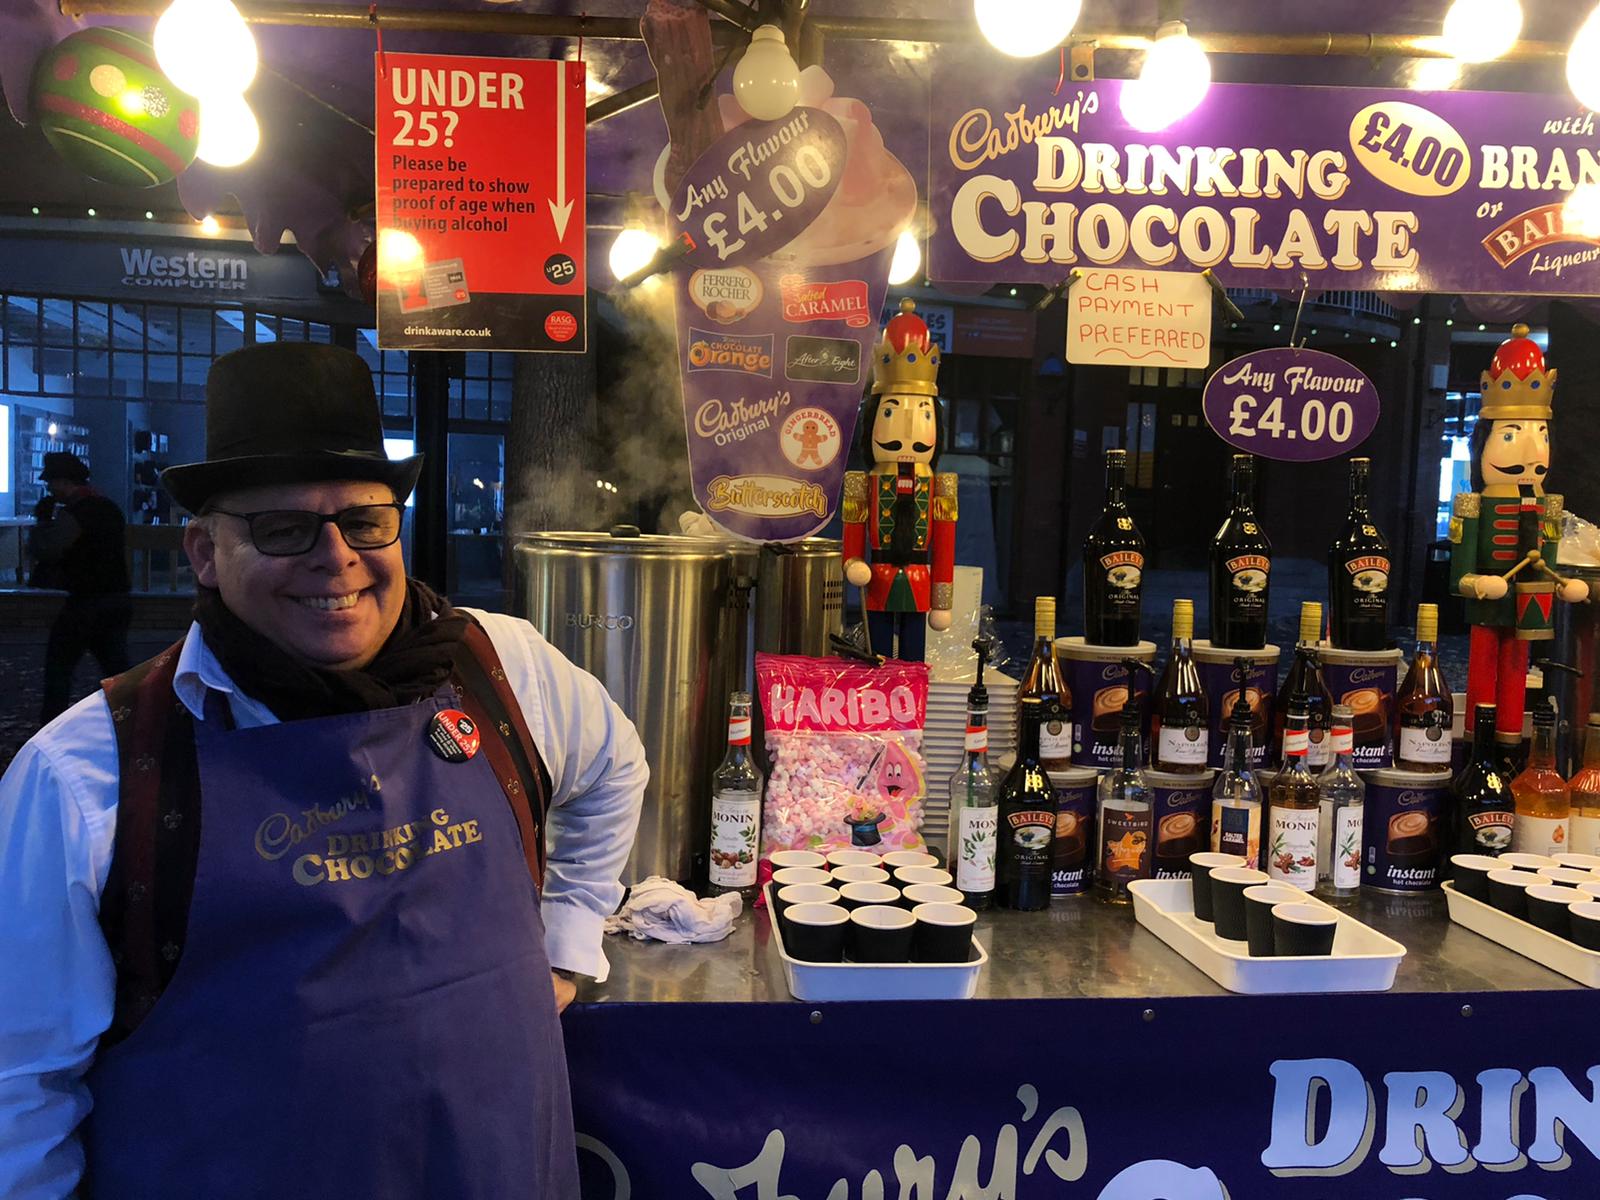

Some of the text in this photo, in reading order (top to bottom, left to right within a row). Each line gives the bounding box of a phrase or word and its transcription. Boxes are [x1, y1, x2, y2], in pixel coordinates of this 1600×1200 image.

[392, 67, 525, 110] UNDER
[392, 110, 459, 148] 25?
[949, 90, 1099, 171] Cadbury's
[1543, 112, 1594, 136] with
[1358, 111, 1465, 188] £4.00
[393, 155, 467, 172] Please be
[677, 110, 810, 223] Any Flavour
[1033, 136, 1350, 200] DRINKING
[393, 176, 530, 194] prepared to show
[393, 194, 536, 214] proof of age when
[703, 145, 831, 261] £4.00
[393, 215, 508, 234] buying alcohol
[951, 174, 1420, 273] CHOCOLATE
[120, 248, 248, 279] Western
[121, 277, 247, 289] COMPUTER
[702, 274, 752, 289] FERRERO
[702, 286, 750, 300] ROCHER
[1086, 272, 1159, 292] CASH
[785, 296, 867, 318] CARAMEL
[1078, 296, 1195, 318] PAYMENT
[404, 325, 492, 338] drinkaware.co.uk
[1079, 323, 1206, 350] PREFERRED
[690, 339, 771, 372] Orange
[711, 341, 764, 353] CHOCOLATE
[1223, 362, 1365, 396] Any Flavour
[694, 390, 791, 438] Cadbury's
[784, 410, 837, 439] GINGERBREAD
[1229, 394, 1354, 443] £4.00
[714, 417, 771, 447] Original
[709, 477, 828, 517] Butterscotch
[771, 683, 917, 726] HARIBO
[713, 811, 754, 824] MONIN
[1011, 813, 1055, 825] BAILEYS
[1276, 819, 1317, 831] MONIN
[1387, 865, 1436, 879] instant
